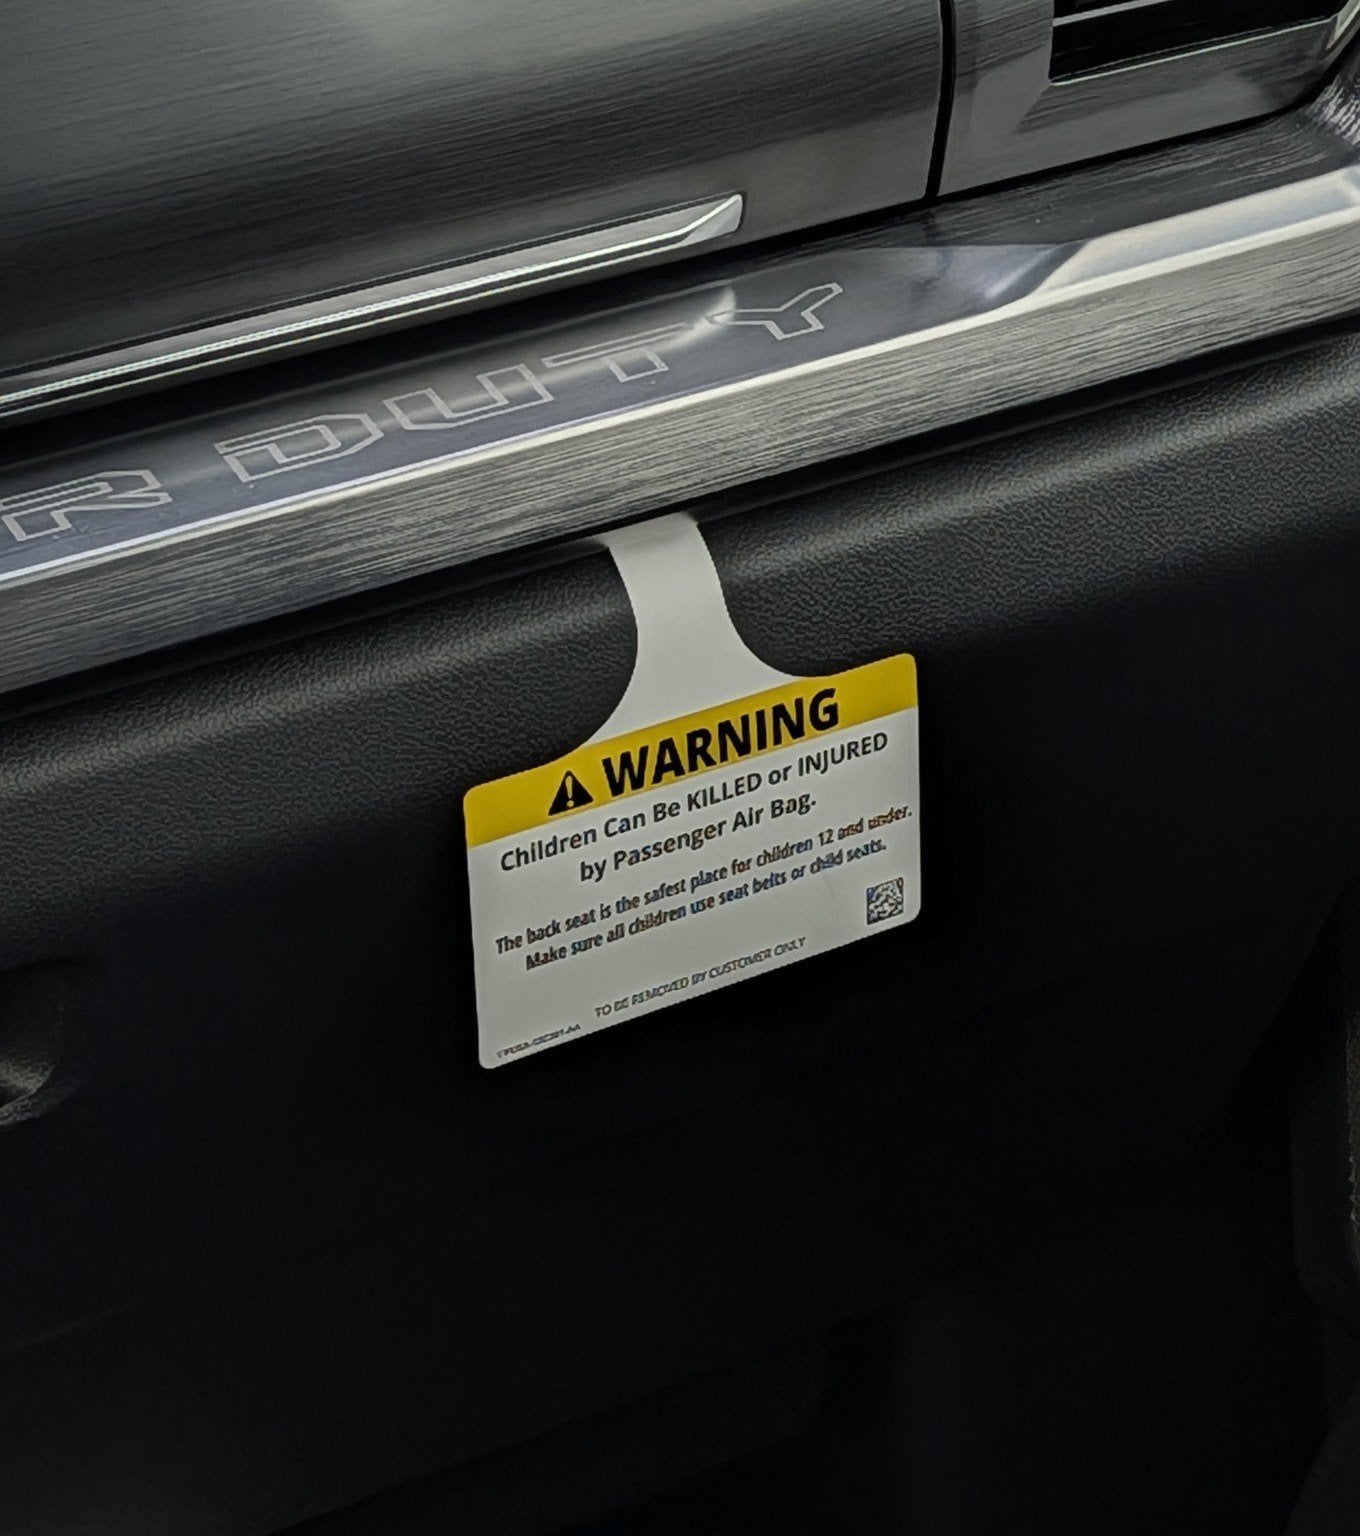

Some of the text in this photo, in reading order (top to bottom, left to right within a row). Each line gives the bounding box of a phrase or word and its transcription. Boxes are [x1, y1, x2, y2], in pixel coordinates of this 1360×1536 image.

[214, 282, 844, 483] DUTY
[500, 731, 888, 871] Children Can Be KILLED or INJURED
[601, 687, 839, 797] WARNING
[495, 934, 523, 955] The
[526, 918, 562, 945] back
[565, 908, 597, 932] seat
[599, 902, 612, 921] is
[615, 895, 641, 915] the
[643, 878, 687, 906] safest
[690, 866, 728, 894] place
[731, 858, 753, 876] for
[756, 837, 814, 868] children
[818, 828, 834, 847] 12
[837, 817, 864, 841] and
[526, 945, 567, 971] Make
[571, 934, 604, 956] sure
[606, 922, 625, 943] all
[628, 904, 687, 936] children
[690, 895, 716, 915] use
[718, 882, 750, 906] seat
[752, 870, 787, 895] belts
[790, 864, 806, 881] or
[846, 838, 887, 863] seats.
[580, 793, 817, 883] by Passenger Air Bag.
[595, 1003, 613, 1018] TO
